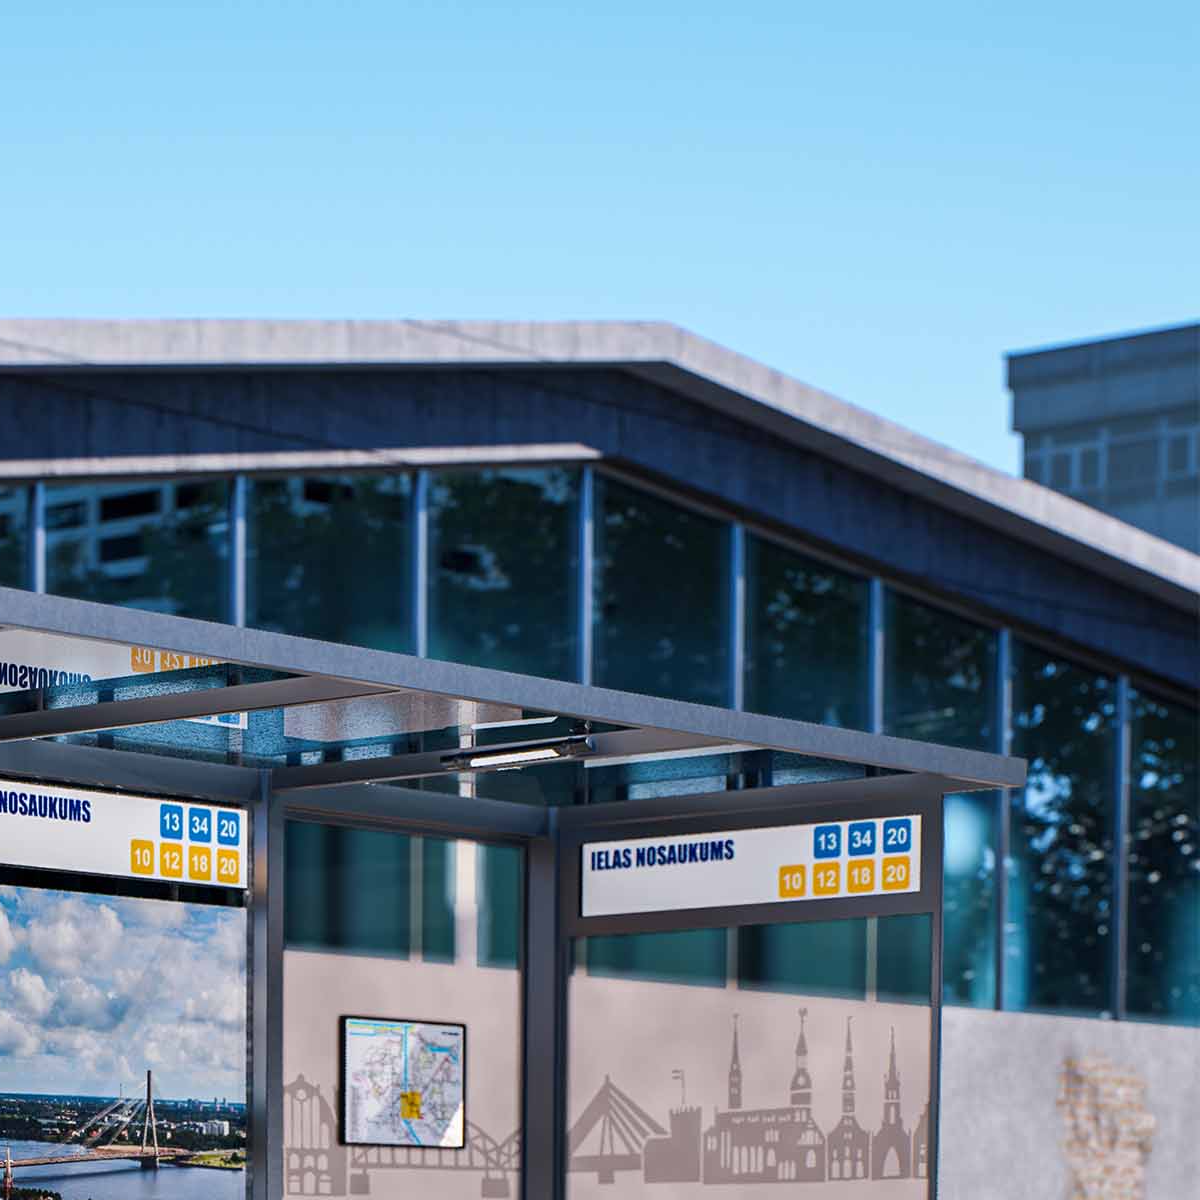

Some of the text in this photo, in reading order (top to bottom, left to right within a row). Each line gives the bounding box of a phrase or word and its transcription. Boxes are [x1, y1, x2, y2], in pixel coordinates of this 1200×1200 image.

[163, 812, 237, 838] 13 34 20
[818, 827, 907, 851] 13 34 20
[134, 847, 237, 875] 10 12 18 20
[591, 839, 735, 871] IELAS NOSAUKUMS
[783, 863, 906, 890] 10 12 18 20
